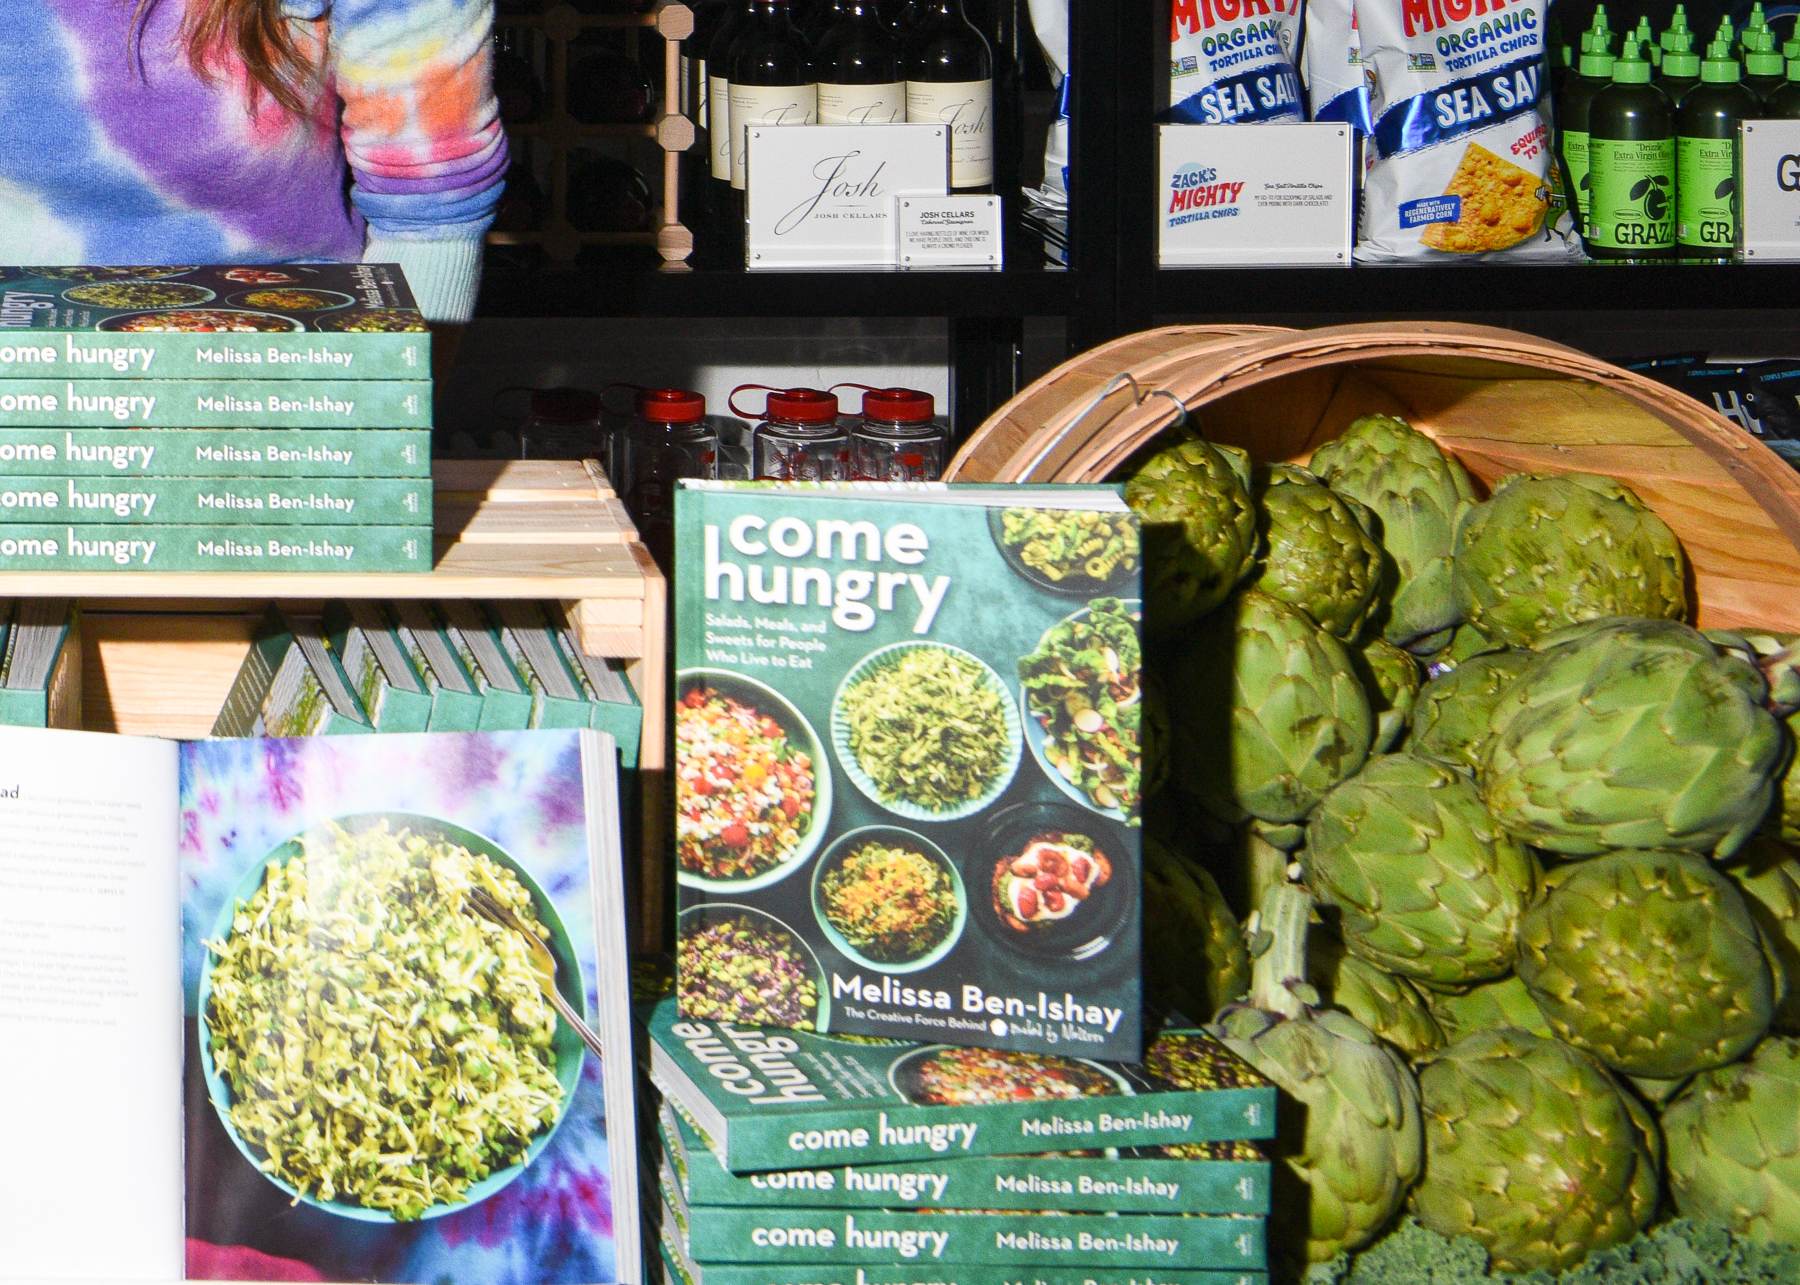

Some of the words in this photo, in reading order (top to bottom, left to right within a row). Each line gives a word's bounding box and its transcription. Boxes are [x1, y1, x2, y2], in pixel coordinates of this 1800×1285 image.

[1436, 8, 1537, 57] ORGANIC
[1209, 49, 1263, 72] TORTILLA
[1446, 46, 1499, 72] TORTILLA
[1500, 33, 1538, 54] CHIPS
[1200, 82, 1255, 124] SEA
[1435, 85, 1494, 129] SEA
[1613, 151, 1634, 160] Extra
[1635, 151, 1657, 161] Virgin
[774, 150, 887, 235] Josh
[1171, 167, 1217, 188] ZACK'S
[919, 211, 940, 219] JOSH
[941, 210, 975, 218] CELLARS
[1169, 181, 1246, 214] MIGHTY
[1409, 213, 1435, 223] FARMED
[1435, 209, 1453, 219] CORN
[1169, 211, 1210, 227] TORTILLA
[1211, 207, 1239, 219] CHIPS
[1615, 222, 1675, 244] GRAZ
[66, 334, 155, 371] hungry
[196, 347, 262, 365] Melissa
[267, 347, 353, 368] Ben-Ishay
[67, 382, 155, 419] hungry
[197, 396, 263, 413] Melissa
[268, 396, 354, 416] Ben-Ishay
[67, 527, 155, 564] hungry
[197, 540, 262, 557] Melissa
[267, 540, 354, 560] Ben-Ishay
[729, 514, 929, 564] come
[704, 525, 951, 634] hungry
[833, 973, 952, 1012] Melissa
[962, 986, 1122, 1033] Ben-Ishay
[788, 1127, 869, 1152] come
[879, 1113, 977, 1150] hungry
[1021, 1116, 1093, 1137] Melissa
[1099, 1112, 1193, 1136] Ben-Ishay
